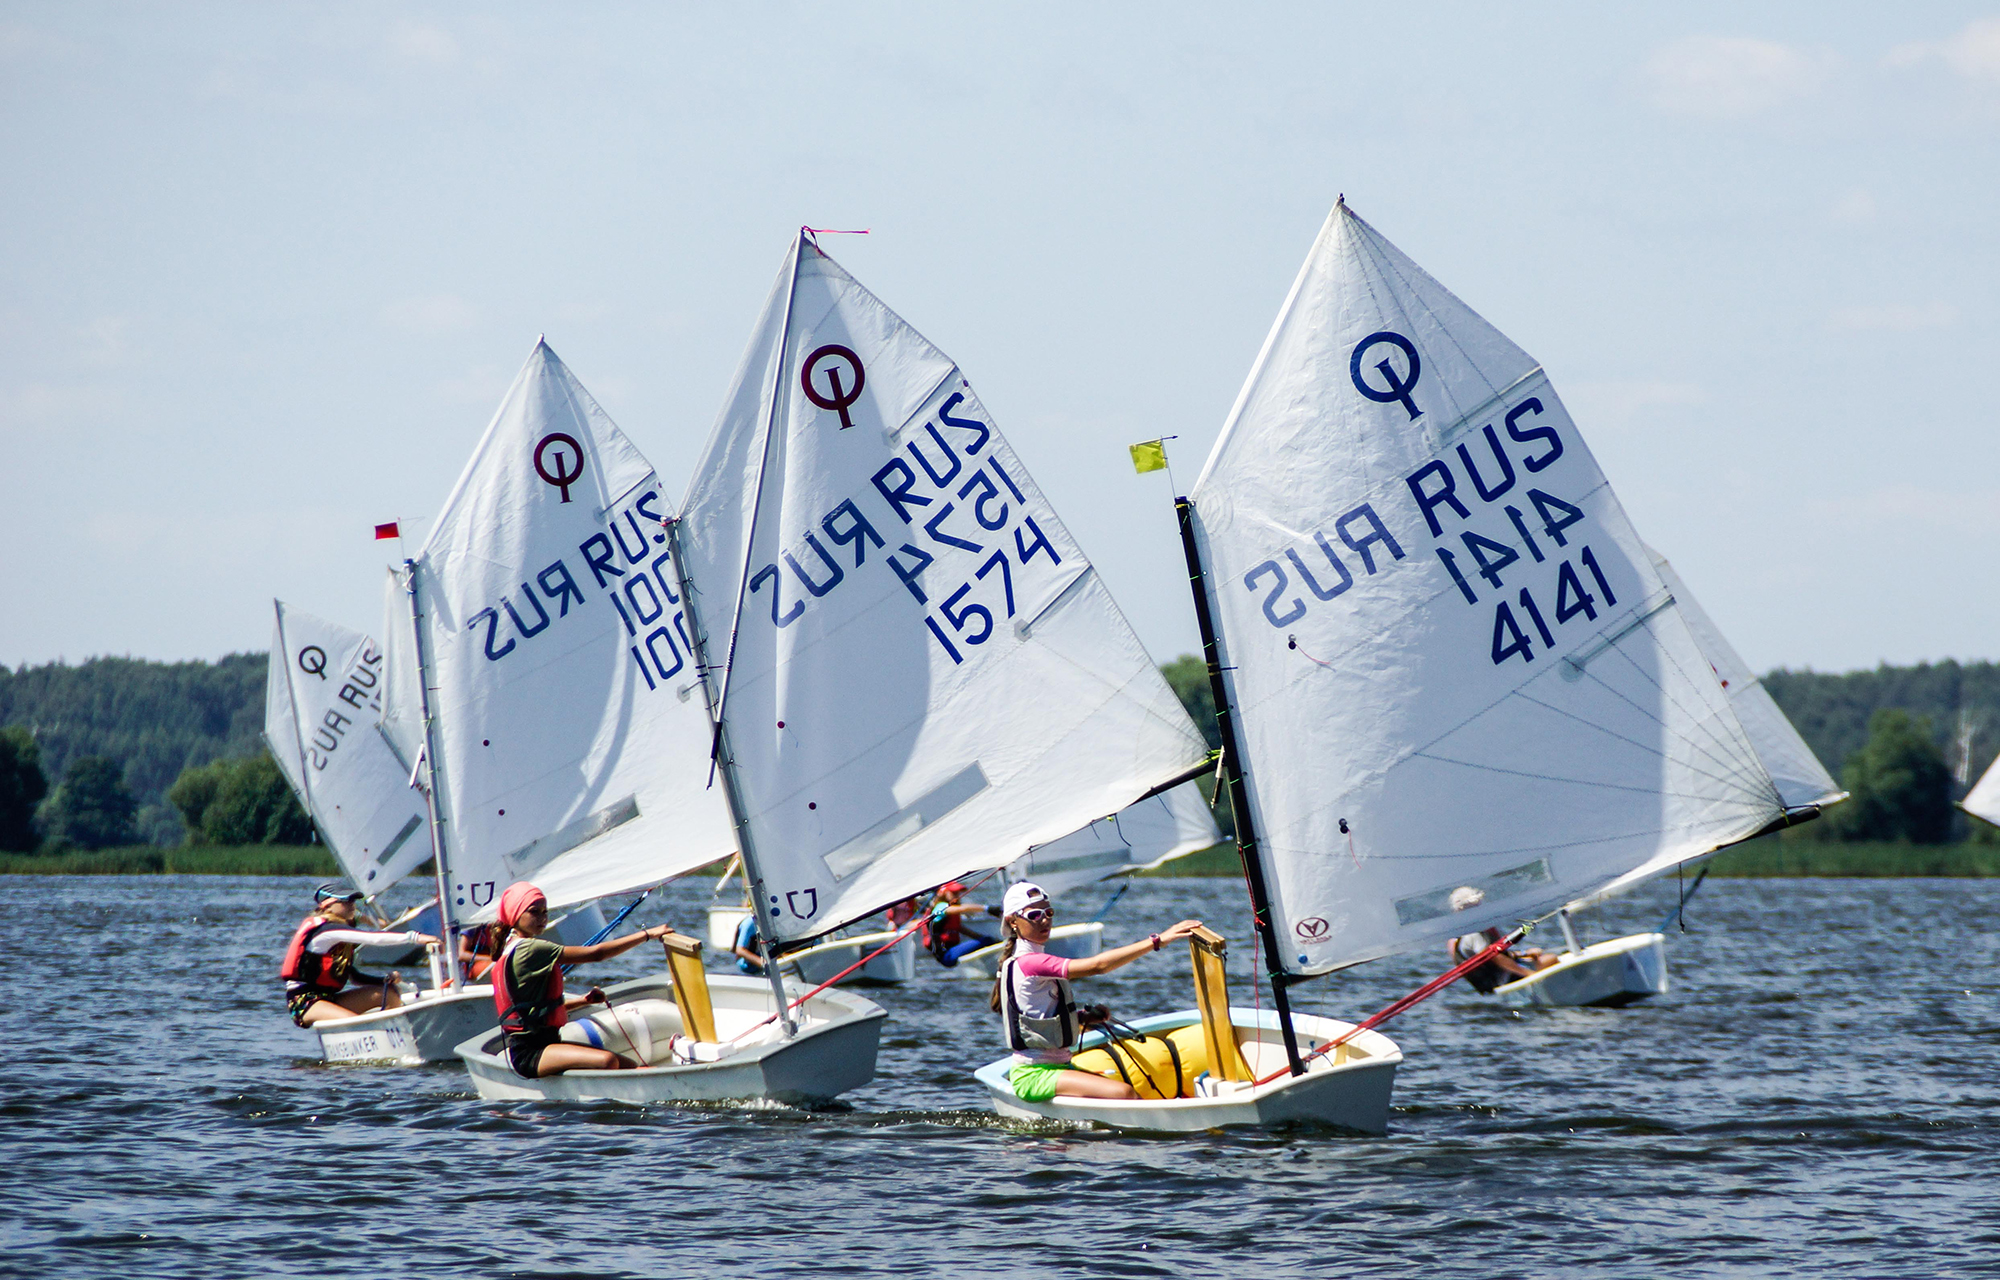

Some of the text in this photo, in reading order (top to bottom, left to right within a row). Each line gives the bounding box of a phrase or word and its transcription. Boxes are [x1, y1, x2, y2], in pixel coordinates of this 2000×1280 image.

[870, 392, 990, 525] RUS
[1405, 397, 1564, 539] RUS
[579, 490, 666, 589] RUS
[924, 515, 1062, 665] 1574
[1491, 545, 1618, 665] 4141
[339, 649, 382, 709] RUS
